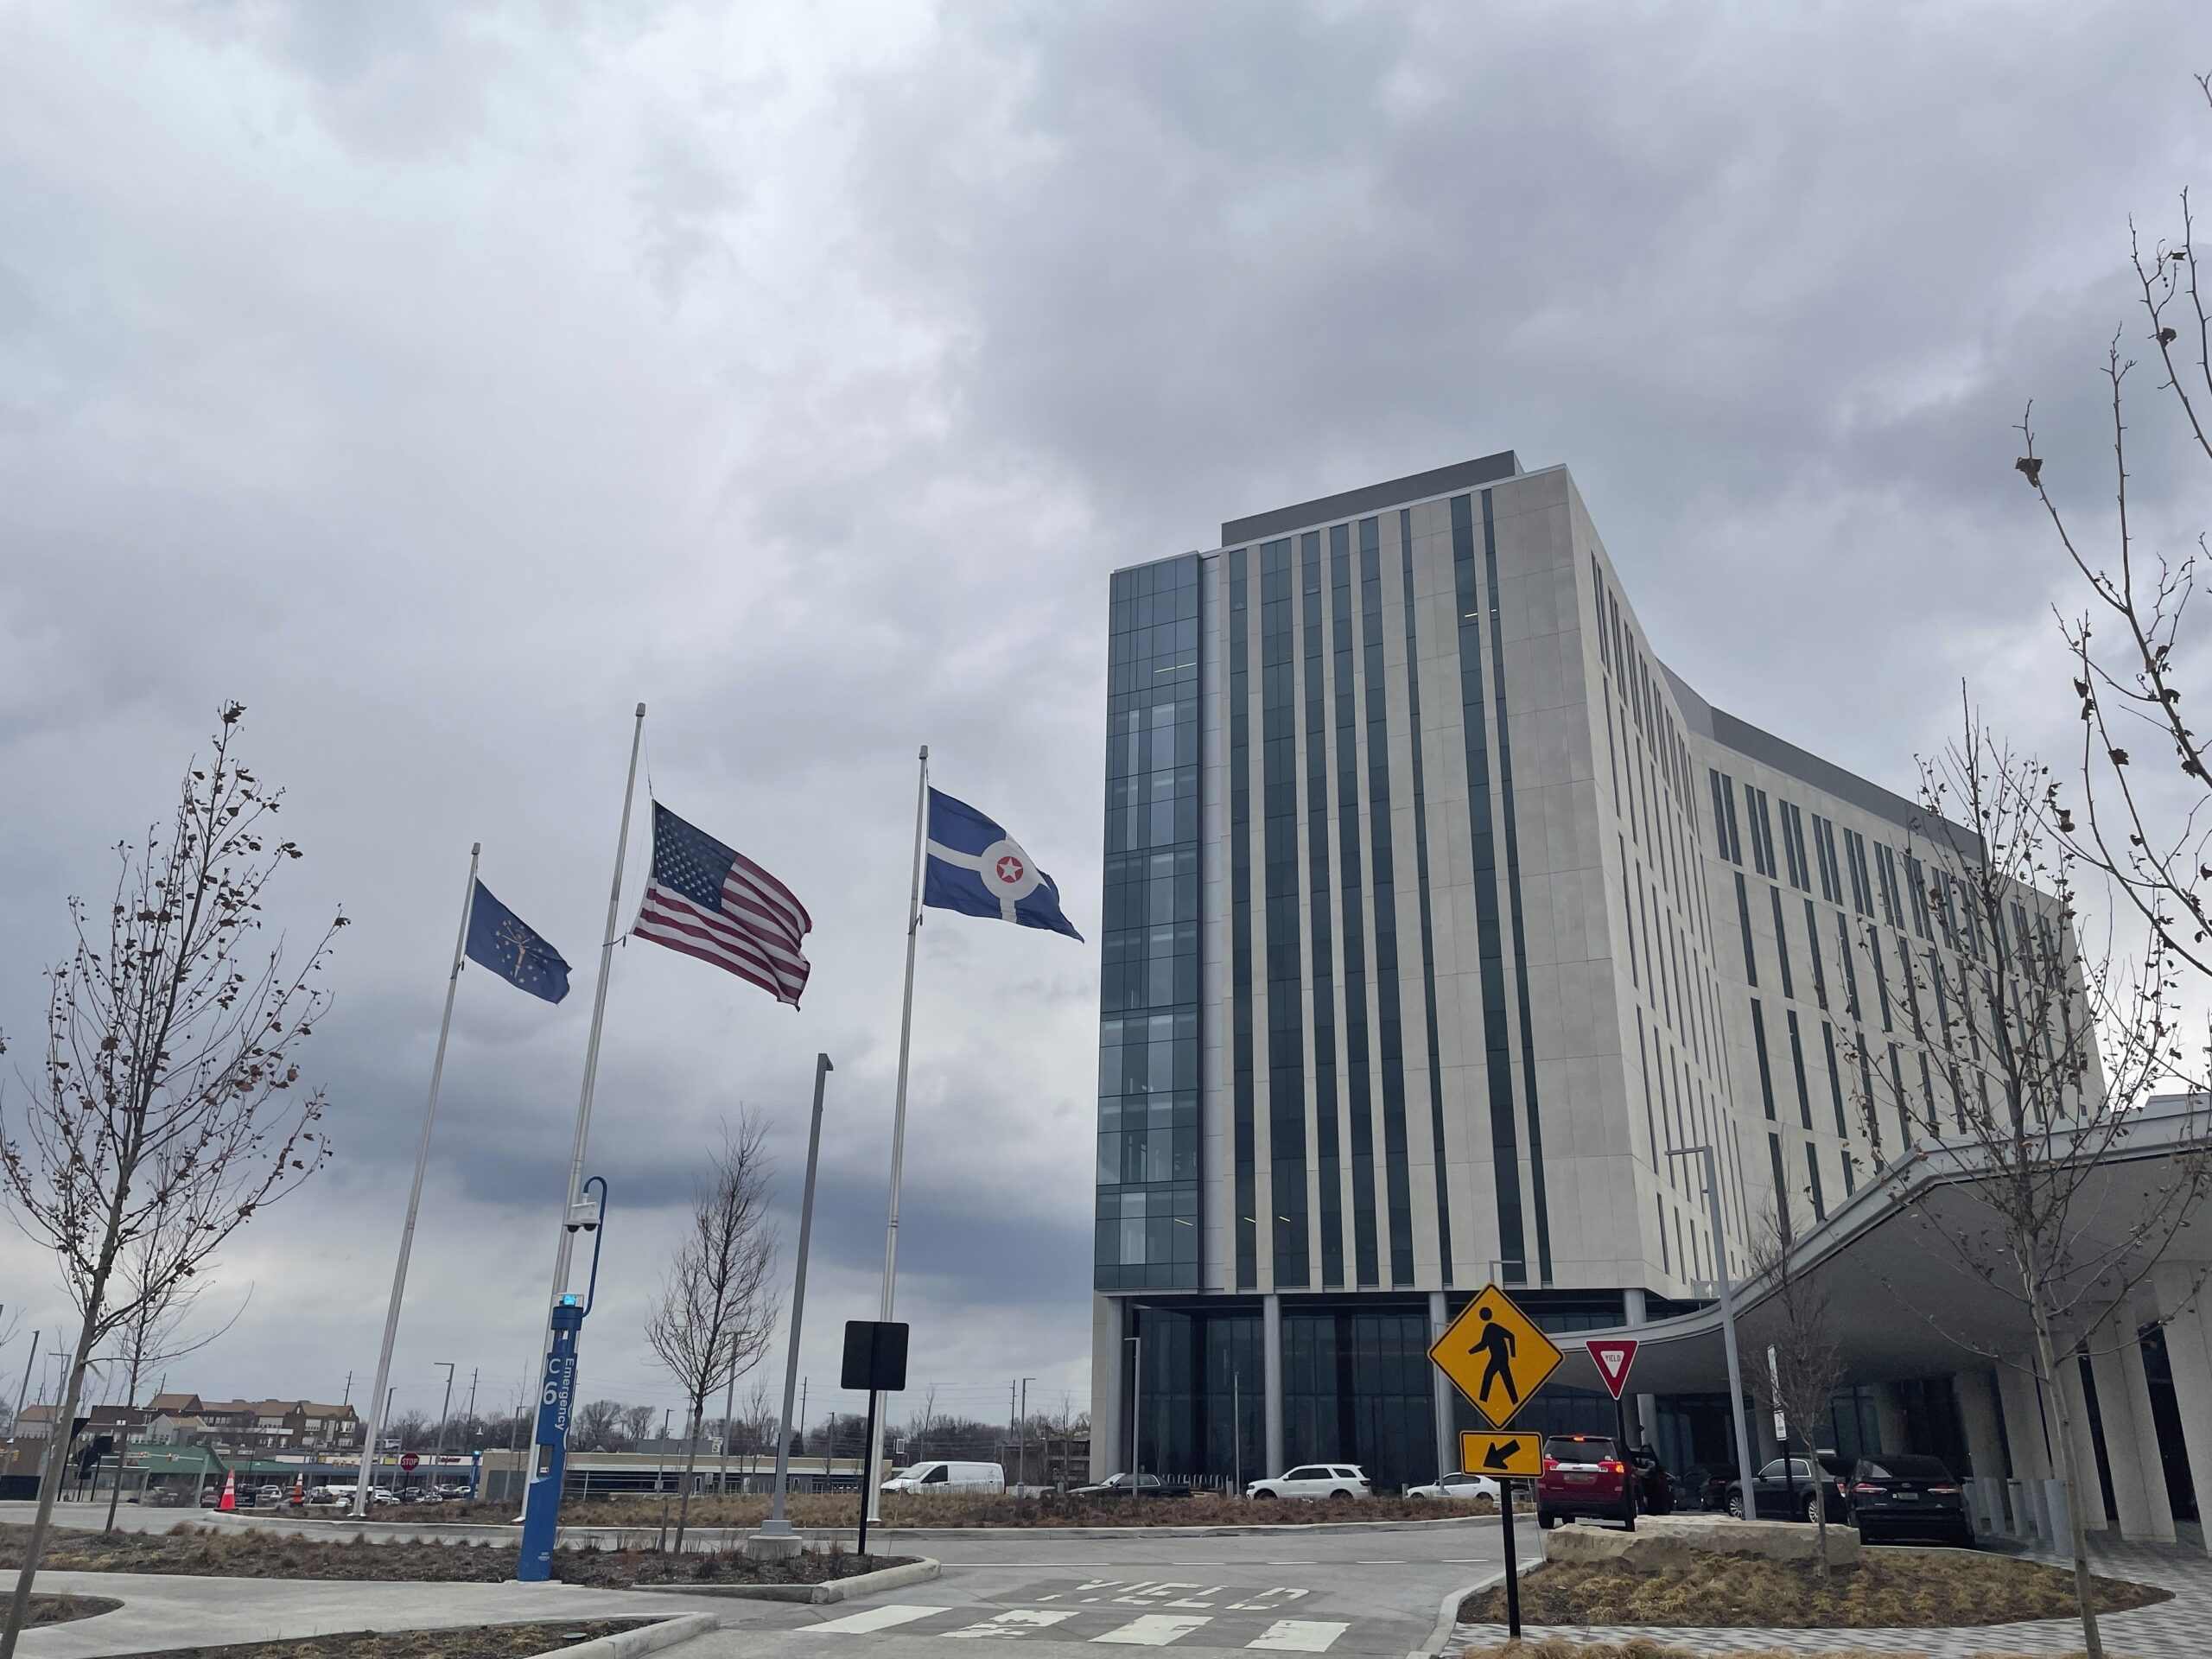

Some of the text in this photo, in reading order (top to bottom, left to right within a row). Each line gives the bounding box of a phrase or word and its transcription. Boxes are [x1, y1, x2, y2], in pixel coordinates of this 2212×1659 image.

[549, 1358, 561, 1374] C
[543, 1382, 558, 1405] 6
[555, 1358, 575, 1431] Emergency
[1036, 1580, 1310, 1611] YIELD
